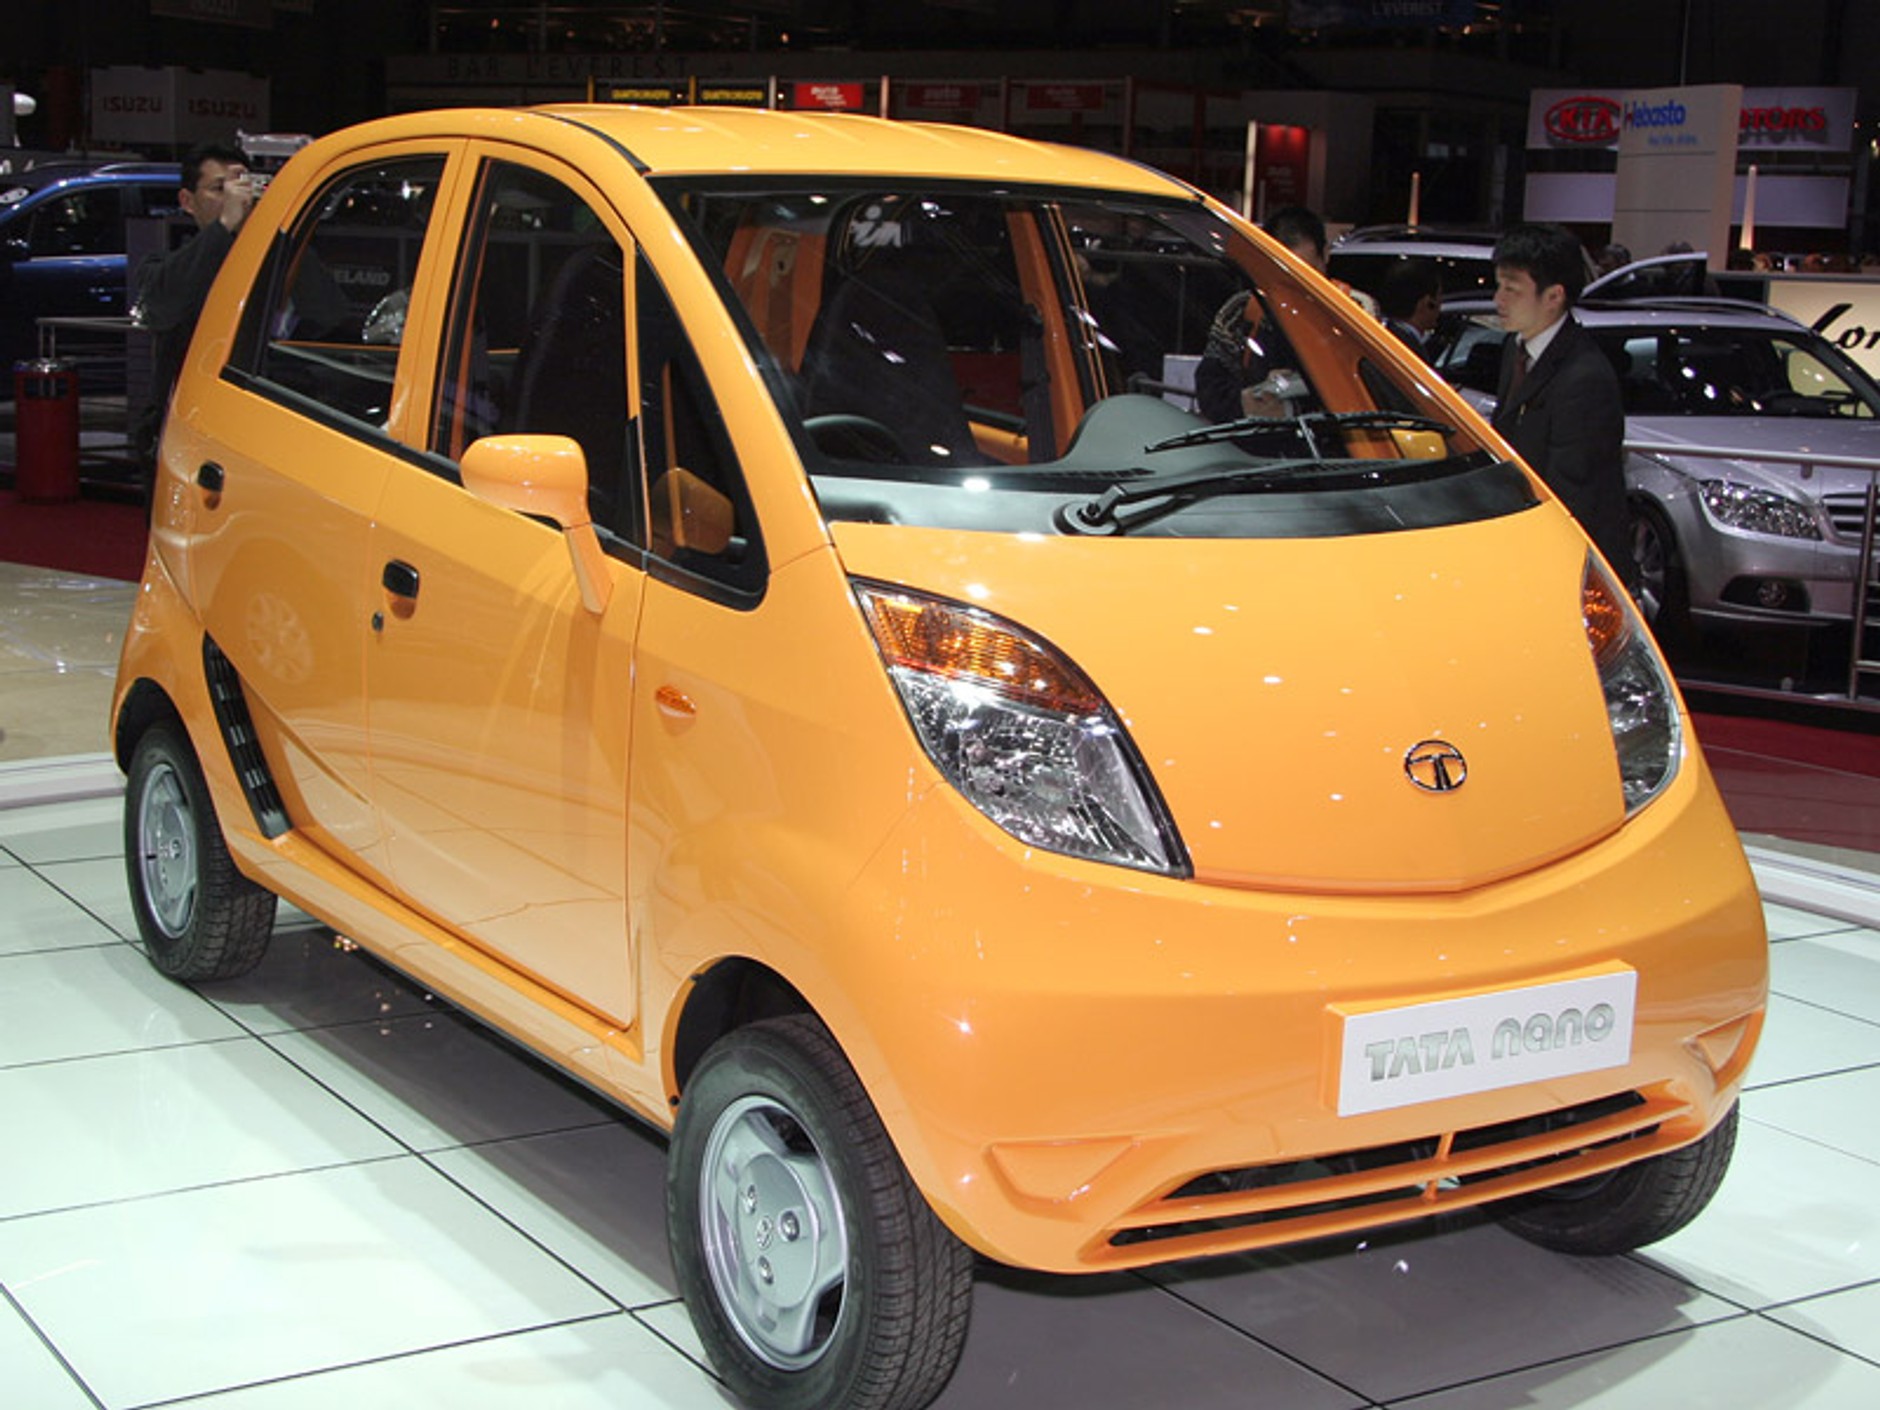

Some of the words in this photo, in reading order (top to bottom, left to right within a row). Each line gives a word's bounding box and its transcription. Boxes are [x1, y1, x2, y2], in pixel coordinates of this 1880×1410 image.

[103, 96, 163, 113] ISUZU
[187, 98, 257, 120] ISUZU
[1559, 106, 1614, 129] KIA
[1364, 1027, 1474, 1083] TATA
[1491, 1002, 1615, 1060] nano
